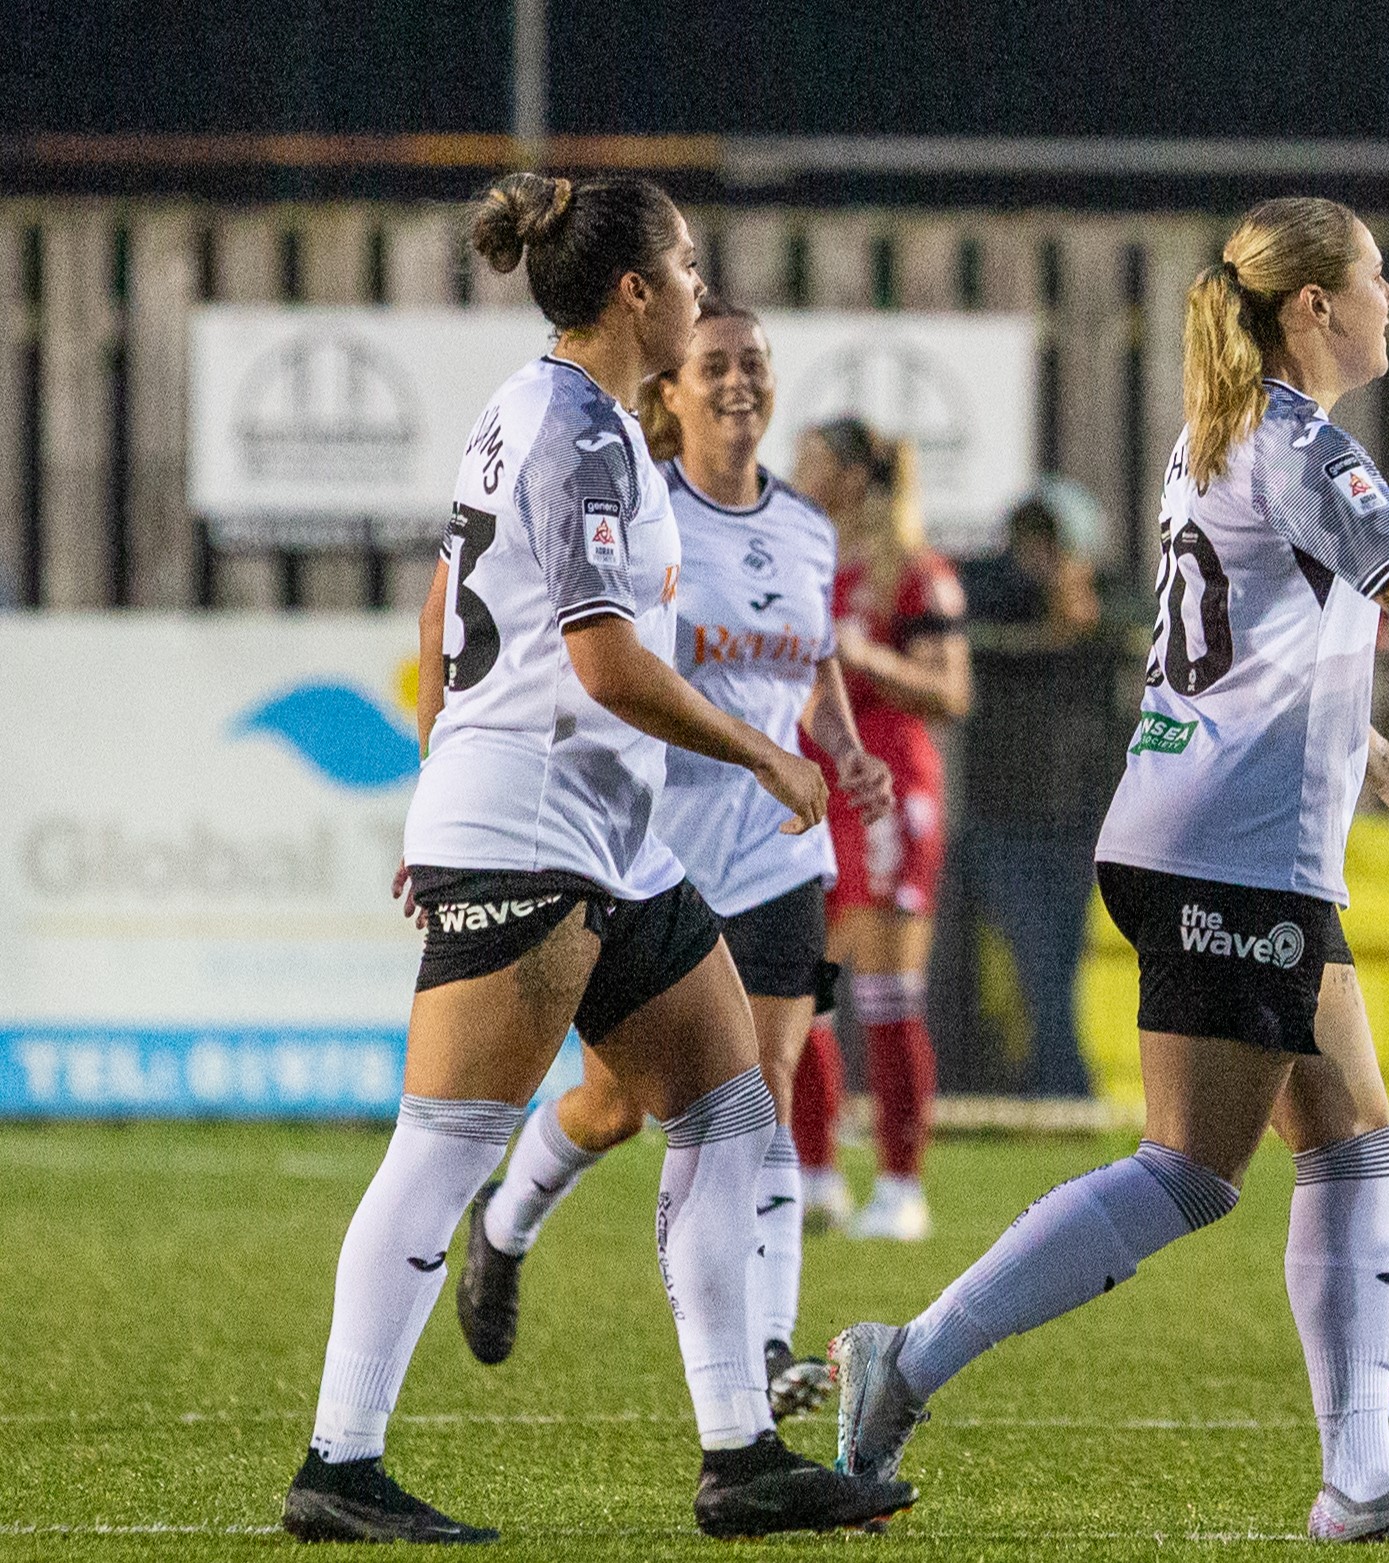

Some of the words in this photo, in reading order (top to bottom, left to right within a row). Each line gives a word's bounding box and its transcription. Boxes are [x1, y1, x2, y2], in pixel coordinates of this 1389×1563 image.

[587, 501, 619, 513] genero
[1181, 904, 1223, 930] the
[1180, 925, 1273, 963] wave
